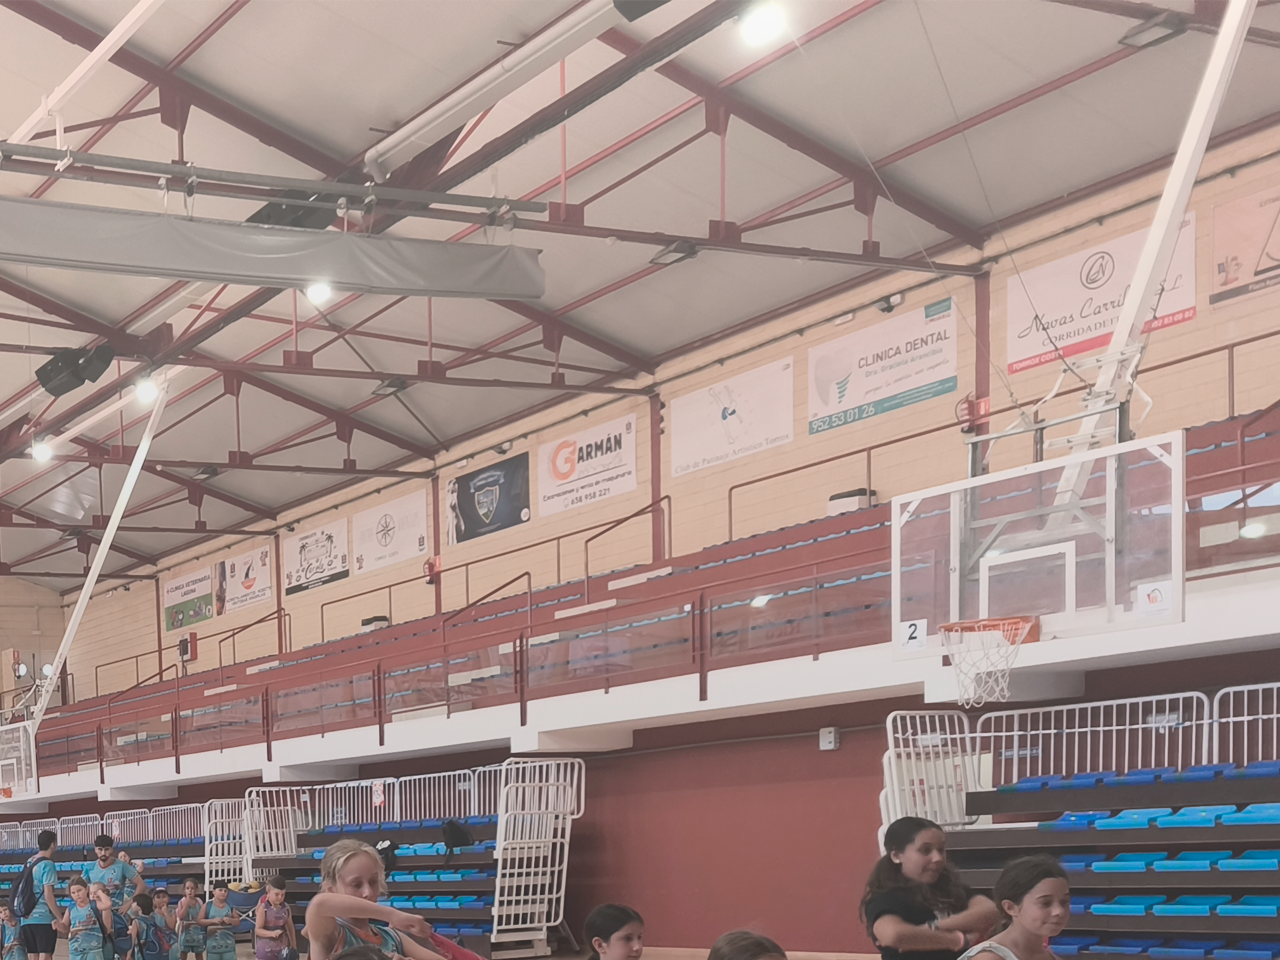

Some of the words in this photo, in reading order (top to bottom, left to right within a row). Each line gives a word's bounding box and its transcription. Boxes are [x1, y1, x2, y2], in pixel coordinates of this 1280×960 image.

[905, 329, 951, 354] DENTAL
[812, 417, 830, 432] 952
[831, 413, 845, 426] 53
[846, 407, 859, 422] 01
[862, 403, 875, 418] 26
[907, 623, 918, 641] 2
